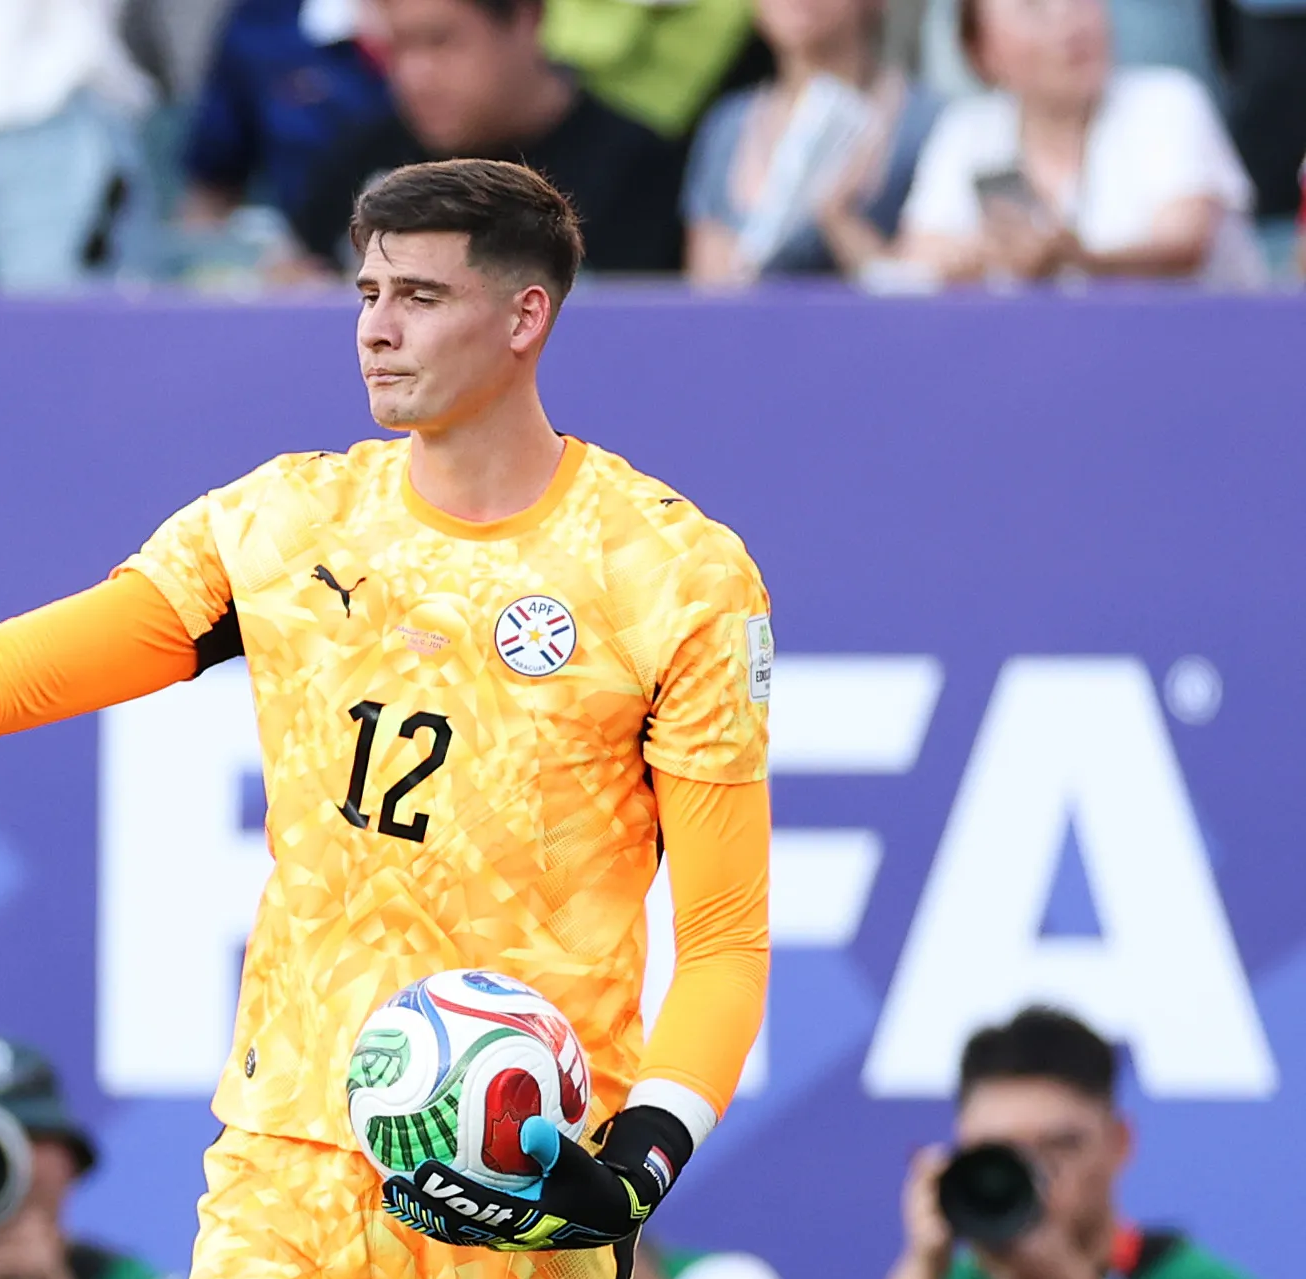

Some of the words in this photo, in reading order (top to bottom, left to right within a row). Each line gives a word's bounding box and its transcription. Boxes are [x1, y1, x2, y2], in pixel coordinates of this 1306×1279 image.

[528, 601, 555, 616] APF
[510, 657, 547, 672] PARAGUAY
[335, 699, 453, 843] 12
[95, 656, 1279, 1099] FFA
[422, 1172, 514, 1227] Voit
